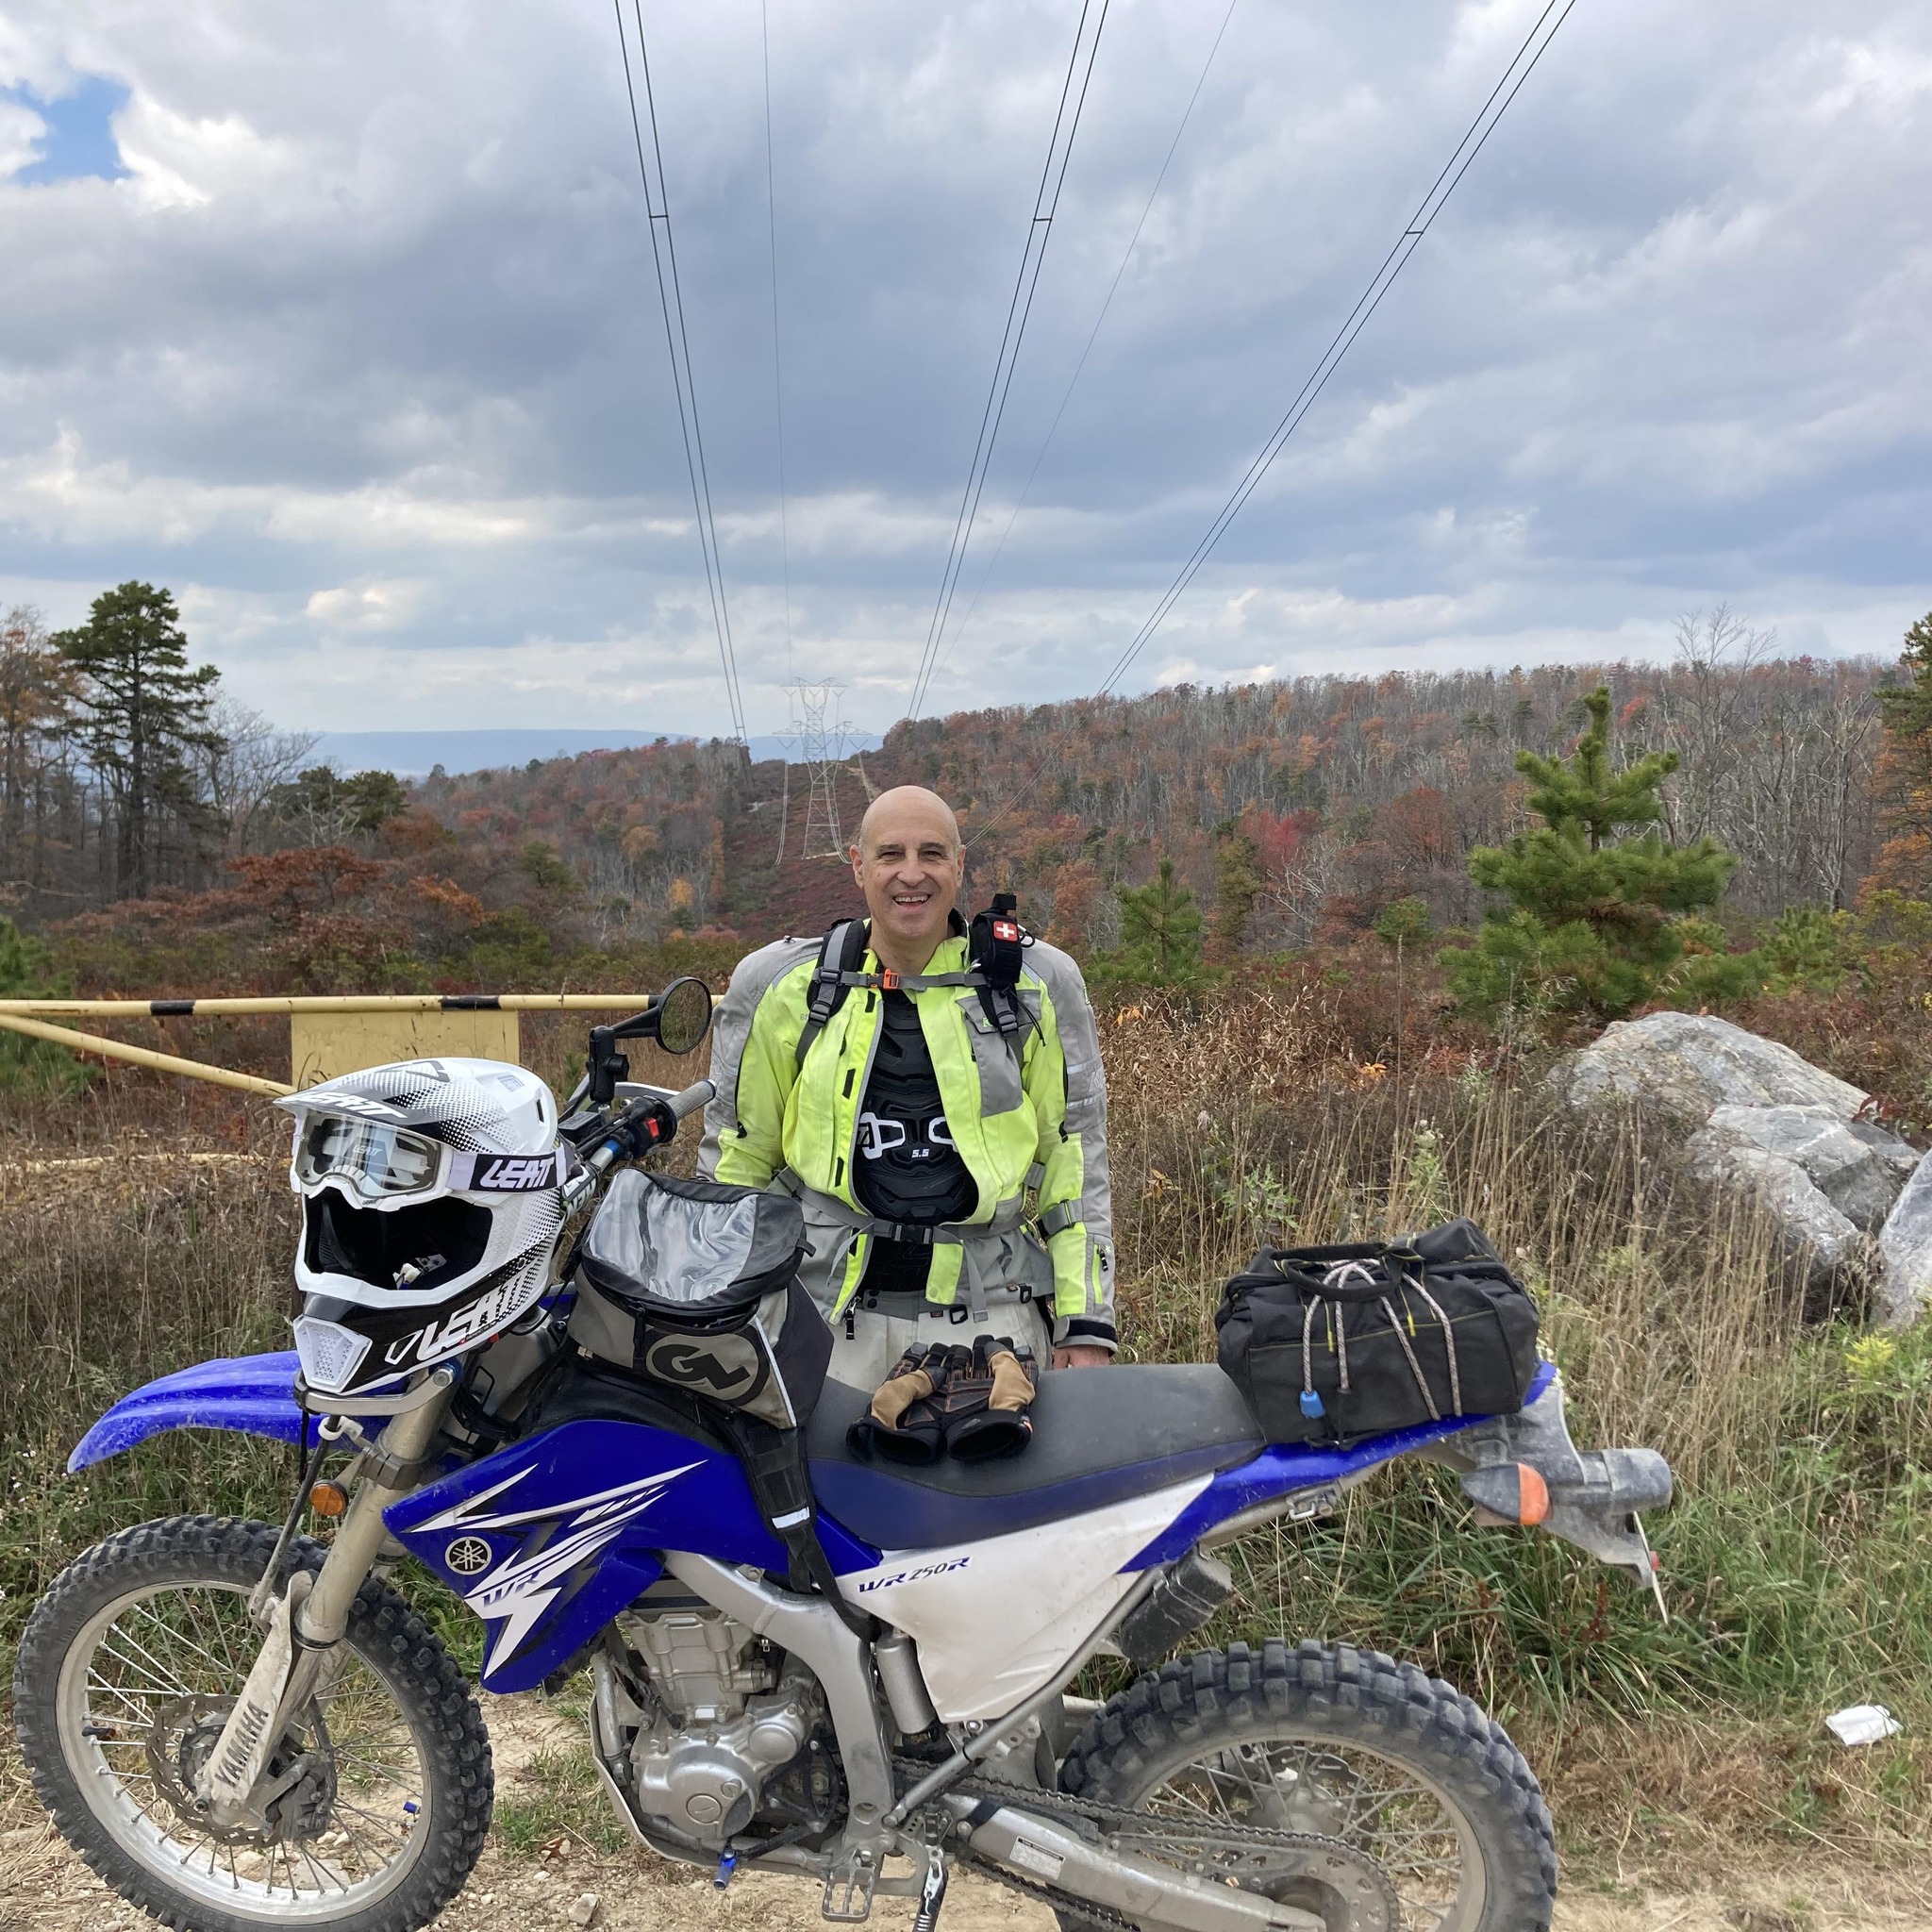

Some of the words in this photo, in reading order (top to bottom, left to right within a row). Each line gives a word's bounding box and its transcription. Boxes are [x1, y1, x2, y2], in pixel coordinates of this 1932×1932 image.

[911, 1148, 929, 1158] 5.5
[479, 1157, 555, 1189] LEATT
[651, 1342, 751, 1391] GL
[482, 1570, 541, 1607] WR
[214, 1700, 269, 1787] YAMAHA
